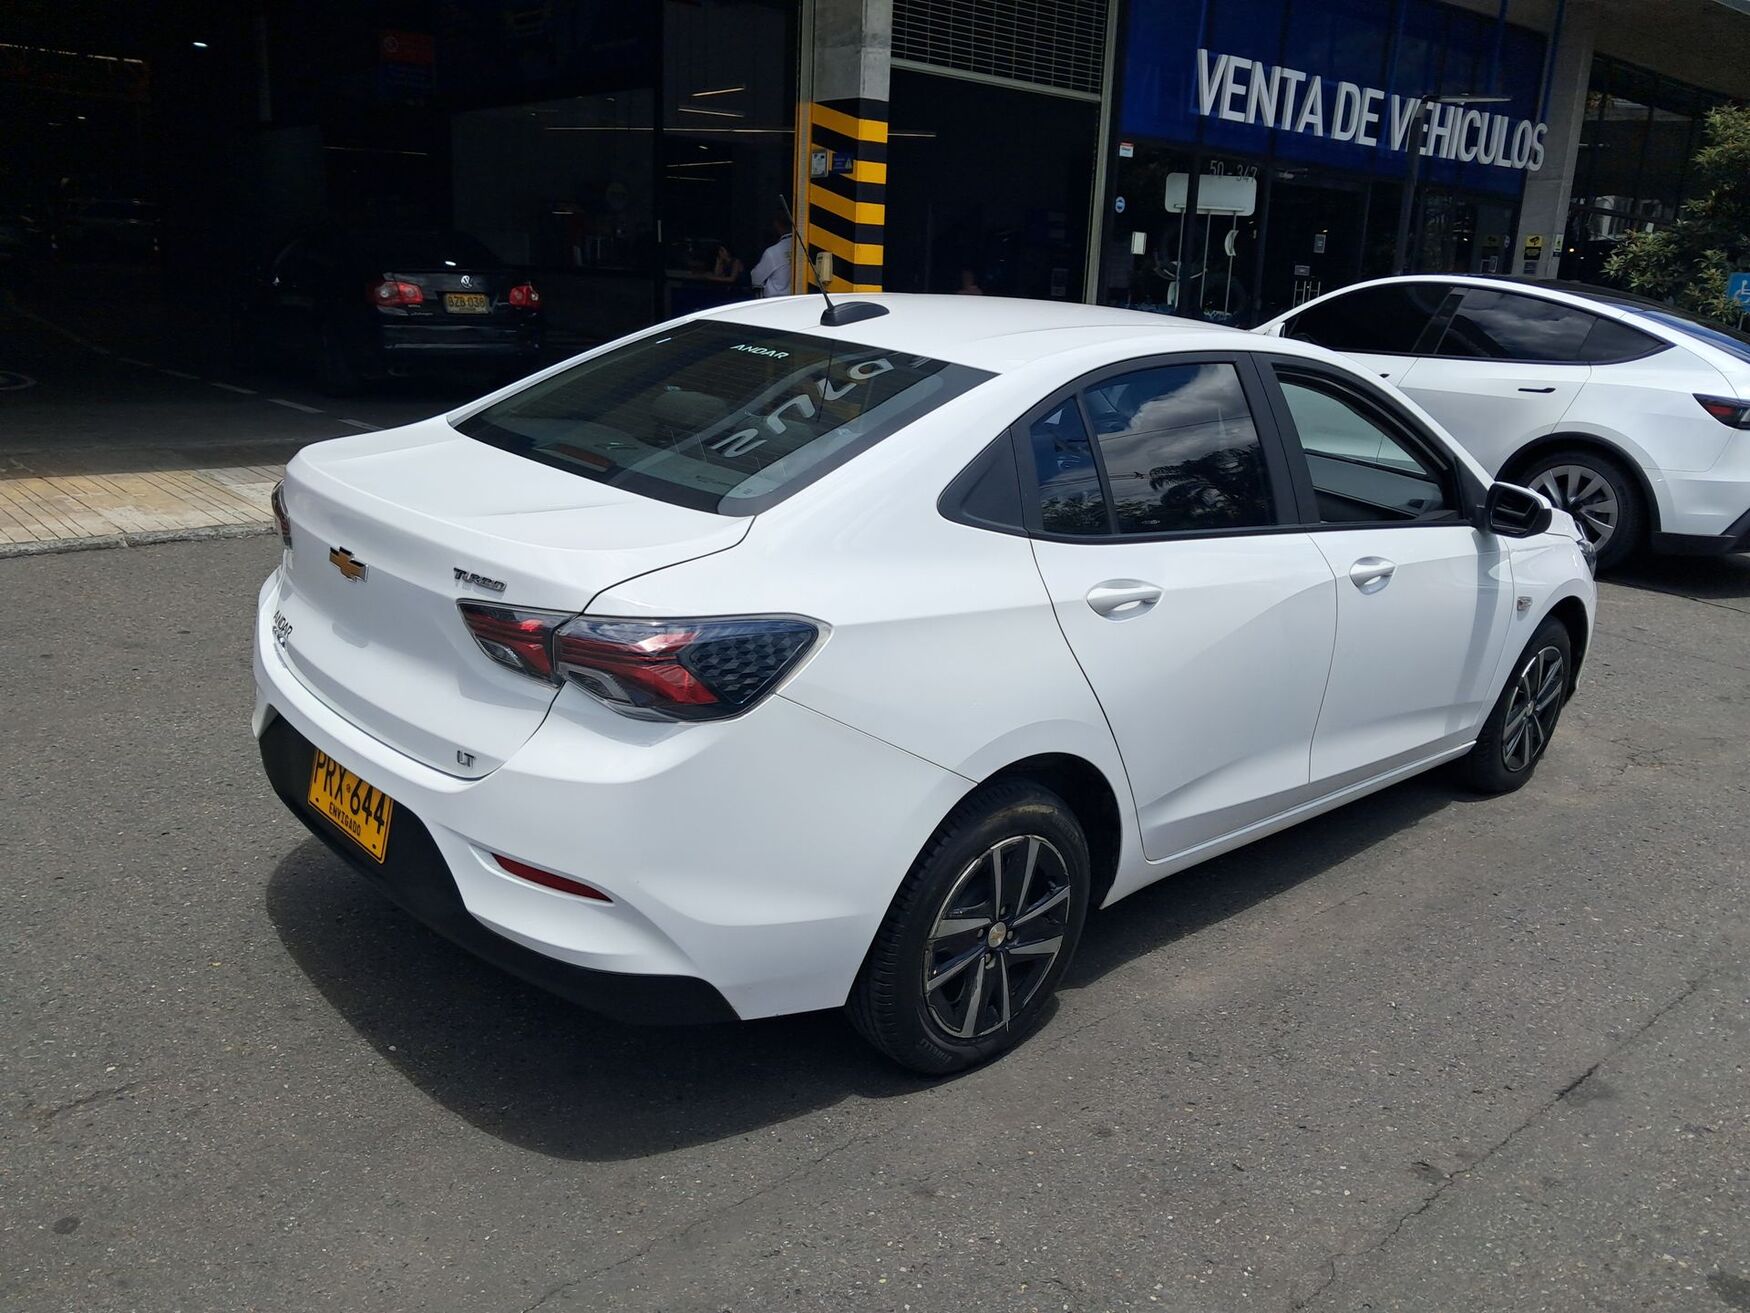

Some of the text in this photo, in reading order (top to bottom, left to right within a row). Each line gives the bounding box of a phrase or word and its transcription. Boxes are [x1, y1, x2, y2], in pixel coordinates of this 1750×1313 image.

[1197, 49, 1324, 137] VENTA
[1331, 80, 1385, 147] DE
[730, 344, 790, 359] ANDAR
[453, 567, 507, 592] TURBO
[456, 750, 476, 769] LT
[314, 749, 386, 835] PRX 644
[328, 801, 362, 837] ENVIGADO
